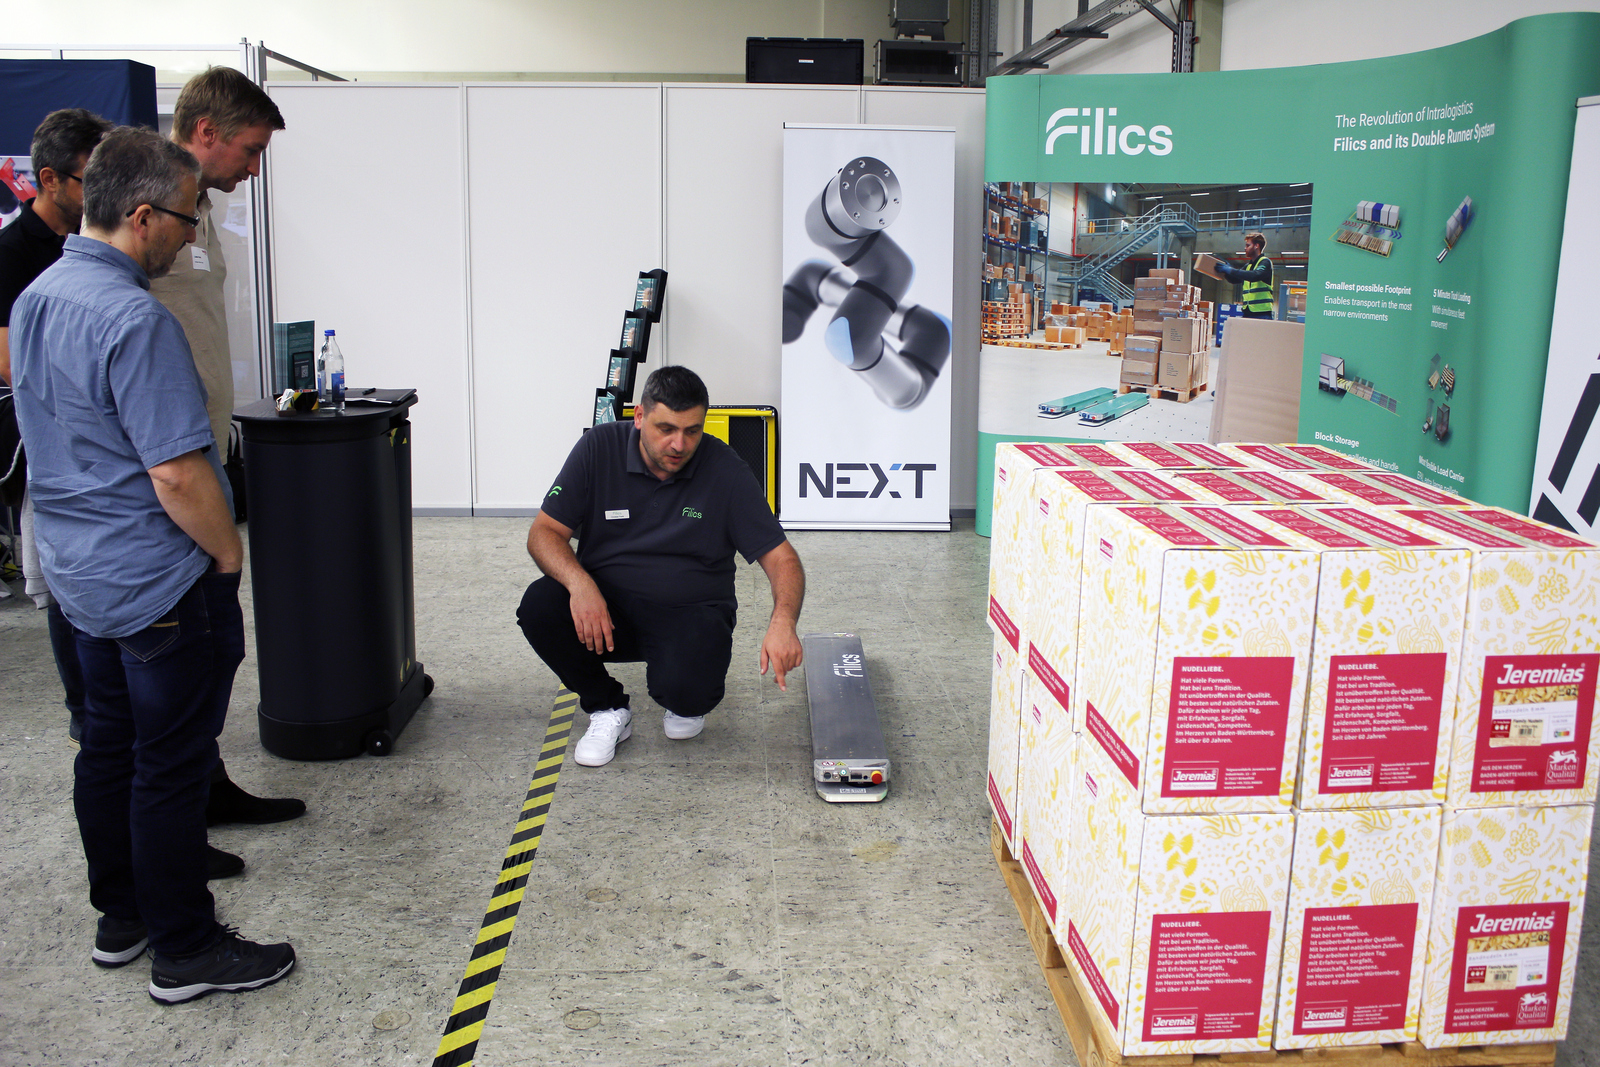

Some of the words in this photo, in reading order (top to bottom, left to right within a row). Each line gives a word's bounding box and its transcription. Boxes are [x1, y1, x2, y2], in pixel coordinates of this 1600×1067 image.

[1335, 115, 1356, 128] The
[1359, 110, 1413, 126] Revolution
[1415, 106, 1427, 122] of
[1427, 100, 1474, 121] Intralogistics
[1045, 107, 1173, 156] Filics
[1333, 137, 1367, 151] Filics
[1370, 134, 1393, 150] and
[1395, 134, 1409, 149] its
[1411, 130, 1445, 147] Double
[1447, 128, 1473, 144] Runner
[1473, 122, 1496, 143] System
[1325, 281, 1355, 291] Smallest
[1356, 284, 1384, 293] possible
[1385, 285, 1412, 296] Footprint
[1324, 295, 1350, 306] Enables
[1352, 298, 1380, 309] transport
[1381, 300, 1387, 308] in
[1388, 300, 1398, 309] the
[1399, 303, 1412, 311] most
[1323, 309, 1346, 318] narrow
[1347, 311, 1388, 322] environments
[1315, 432, 1334, 443] Block
[1335, 435, 1359, 448] Storage
[1381, 459, 1399, 471] handle
[799, 463, 936, 498] NEXT
[1437, 465, 1448, 477] Load
[1449, 469, 1464, 483] Carrier
[1496, 662, 1585, 684] Jeremias
[1344, 711, 1375, 719] Erfahrung,
[1372, 724, 1429, 732] Baden-Württemberg.
[1173, 770, 1216, 781] Jeremias
[1329, 765, 1371, 777] Jeremias
[1546, 770, 1576, 779] Qualität
[1469, 910, 1555, 932] Jeremias
[1304, 1008, 1345, 1020] Jeremias
[1517, 1010, 1546, 1019] Qualität
[1519, 1004, 1547, 1012] Marken
[1153, 1015, 1195, 1026] Jeremias
